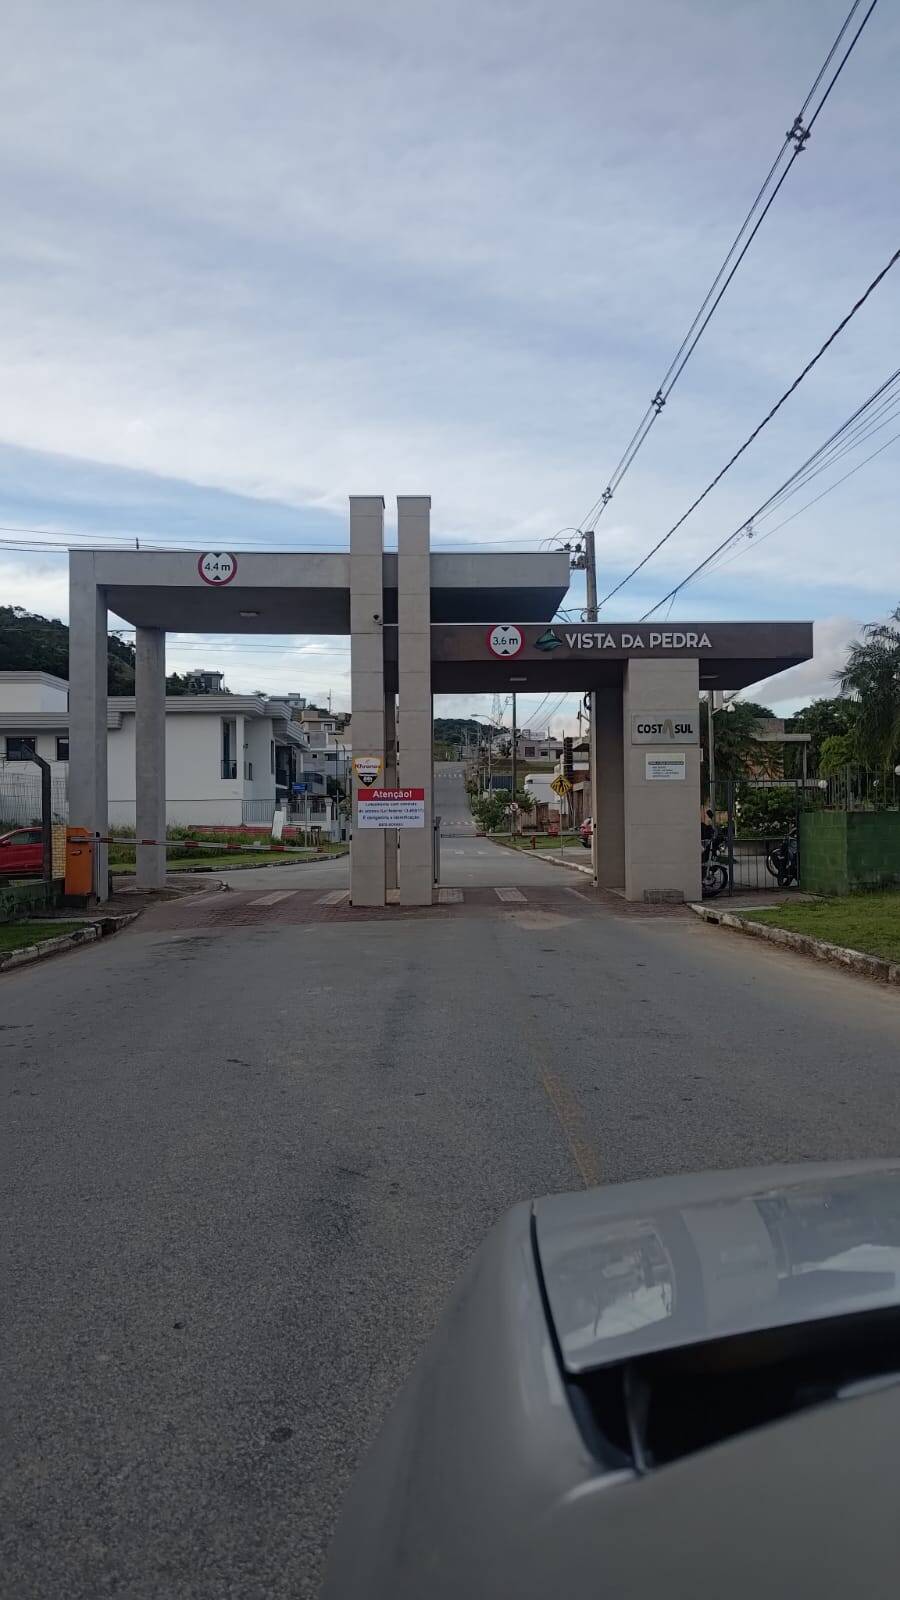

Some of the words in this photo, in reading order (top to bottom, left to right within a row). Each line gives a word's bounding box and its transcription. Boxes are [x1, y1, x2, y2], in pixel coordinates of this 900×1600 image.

[509, 637, 520, 646] m
[565, 632, 616, 649] VISTA
[621, 633, 645, 649] DA
[649, 632, 713, 648] PEDRA
[372, 790, 412, 799] Atenção!
